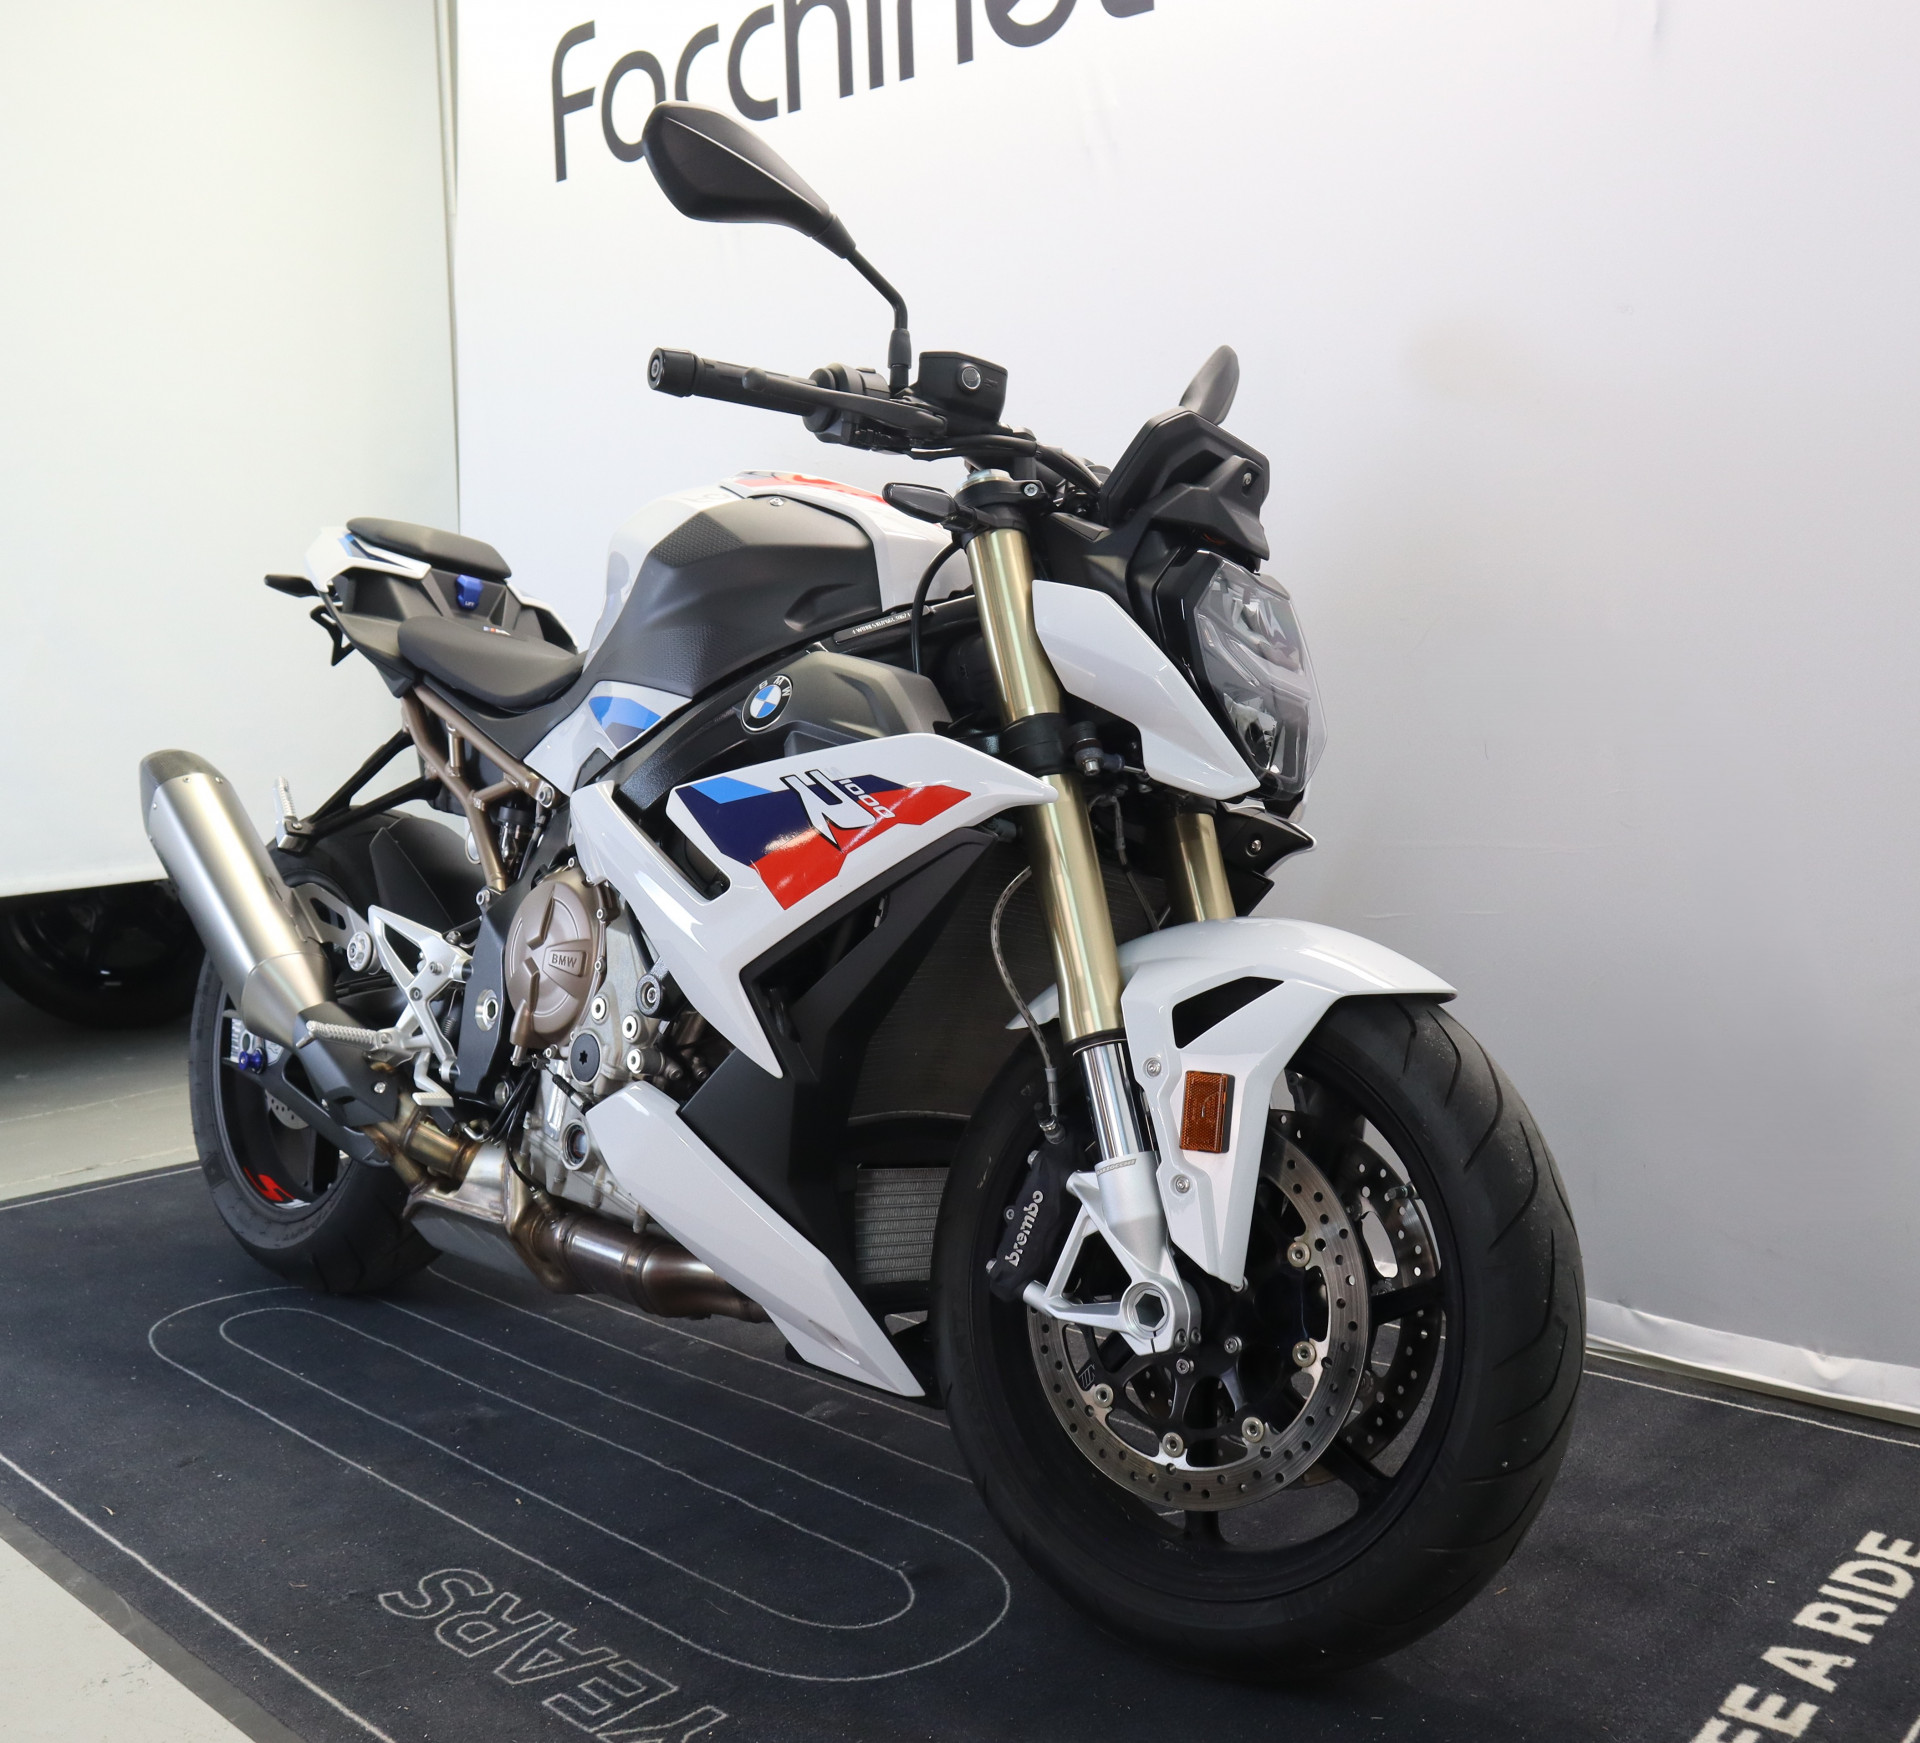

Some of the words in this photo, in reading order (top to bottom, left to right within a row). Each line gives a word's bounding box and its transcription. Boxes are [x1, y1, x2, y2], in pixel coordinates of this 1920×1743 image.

[551, 953, 578, 969] BMW
[1004, 1189, 1044, 1268] brembo
[1792, 1529, 1920, 1646] RIDE
[1760, 1646, 1857, 1694] A
